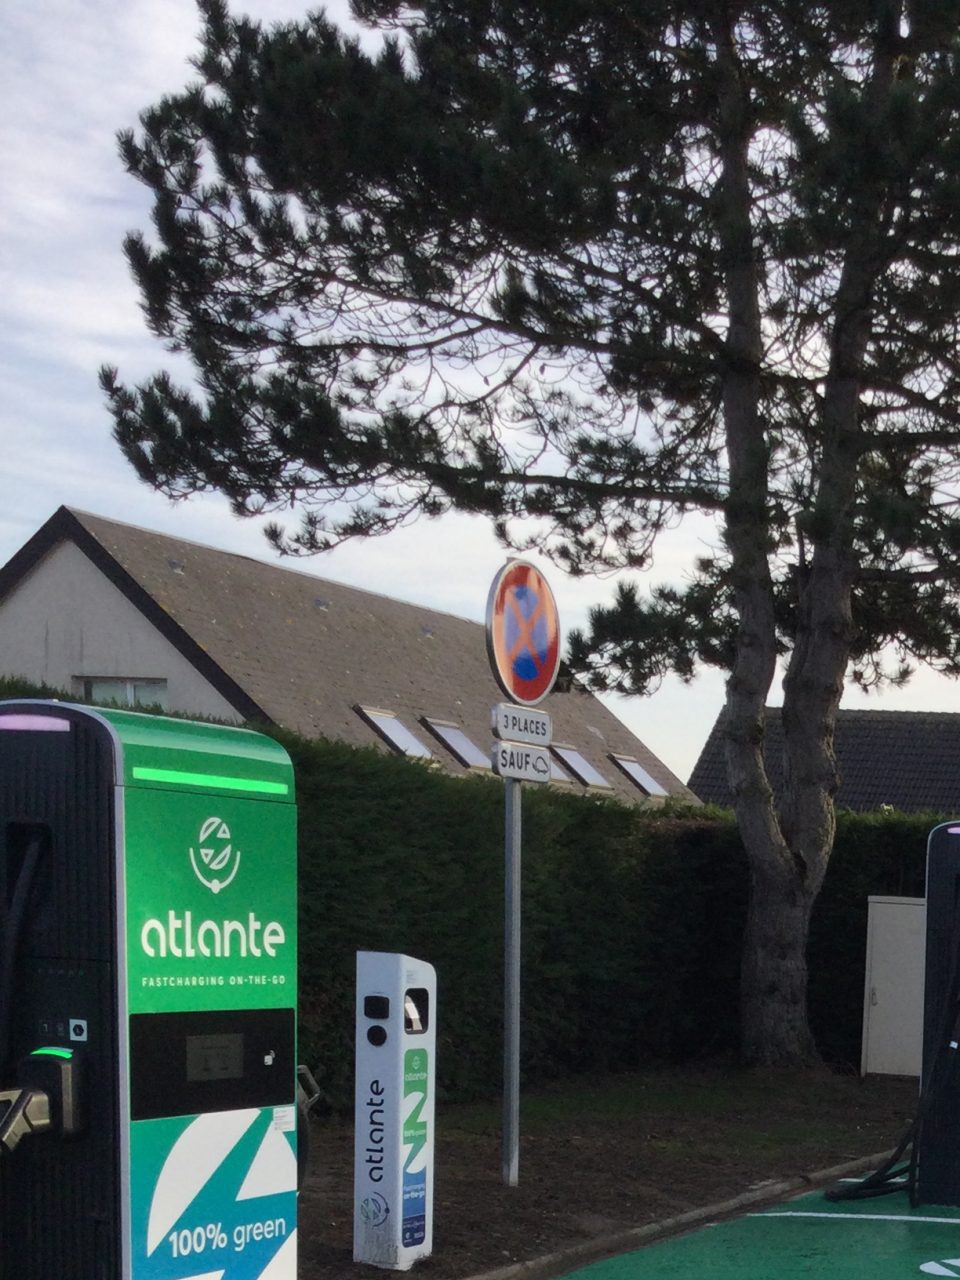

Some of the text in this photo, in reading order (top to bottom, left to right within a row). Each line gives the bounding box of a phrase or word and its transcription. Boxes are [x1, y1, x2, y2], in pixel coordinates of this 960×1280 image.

[503, 714, 547, 737] 3 PLACES
[501, 749, 531, 771] SAUF
[140, 910, 286, 958] atlante
[141, 975, 286, 988] FASTCHARGING ON-THE-GO
[365, 1079, 385, 1183] atlante
[168, 1217, 286, 1258] 100% green
